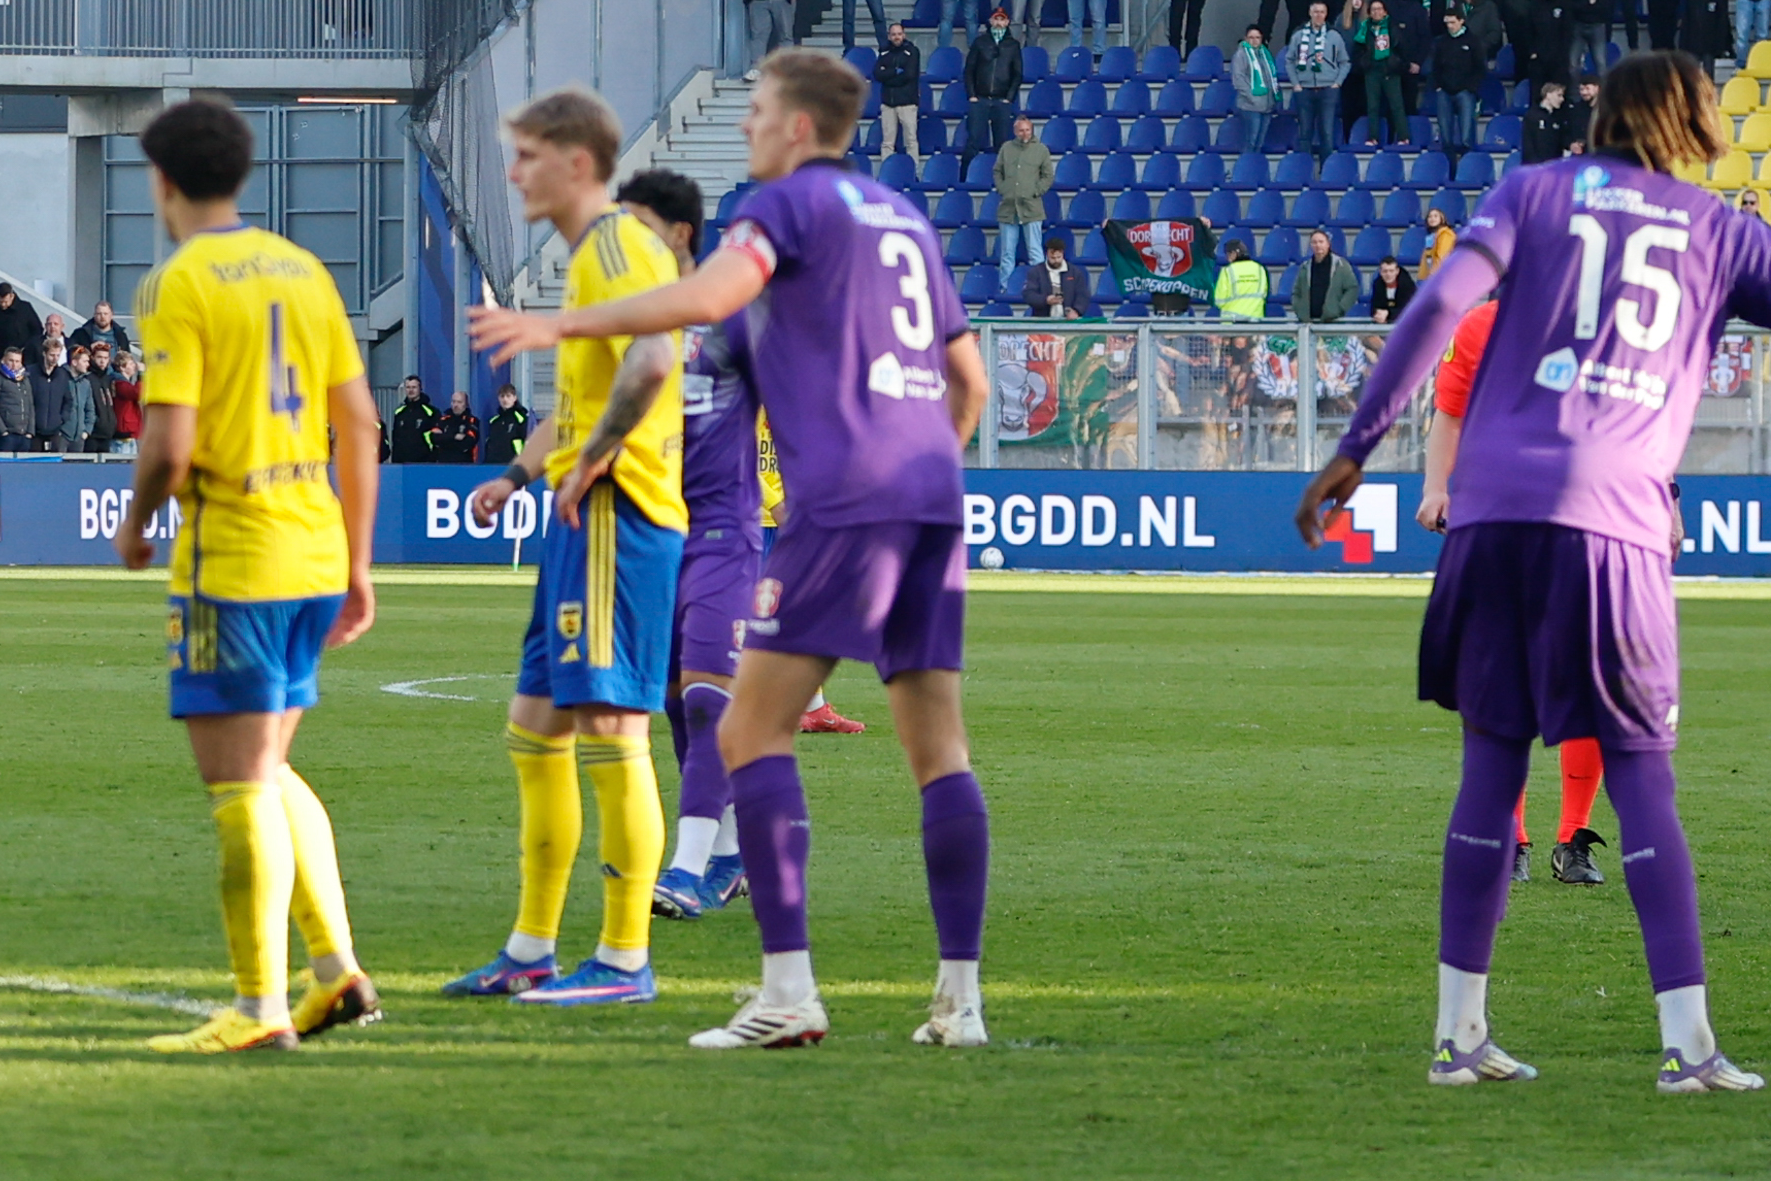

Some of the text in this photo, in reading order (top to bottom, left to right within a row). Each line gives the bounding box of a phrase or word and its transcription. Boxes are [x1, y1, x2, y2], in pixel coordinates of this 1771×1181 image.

[878, 231, 935, 351] 3
[1568, 214, 1690, 353] 15
[270, 302, 303, 433] 4
[963, 493, 1216, 548] BGDD.NL
